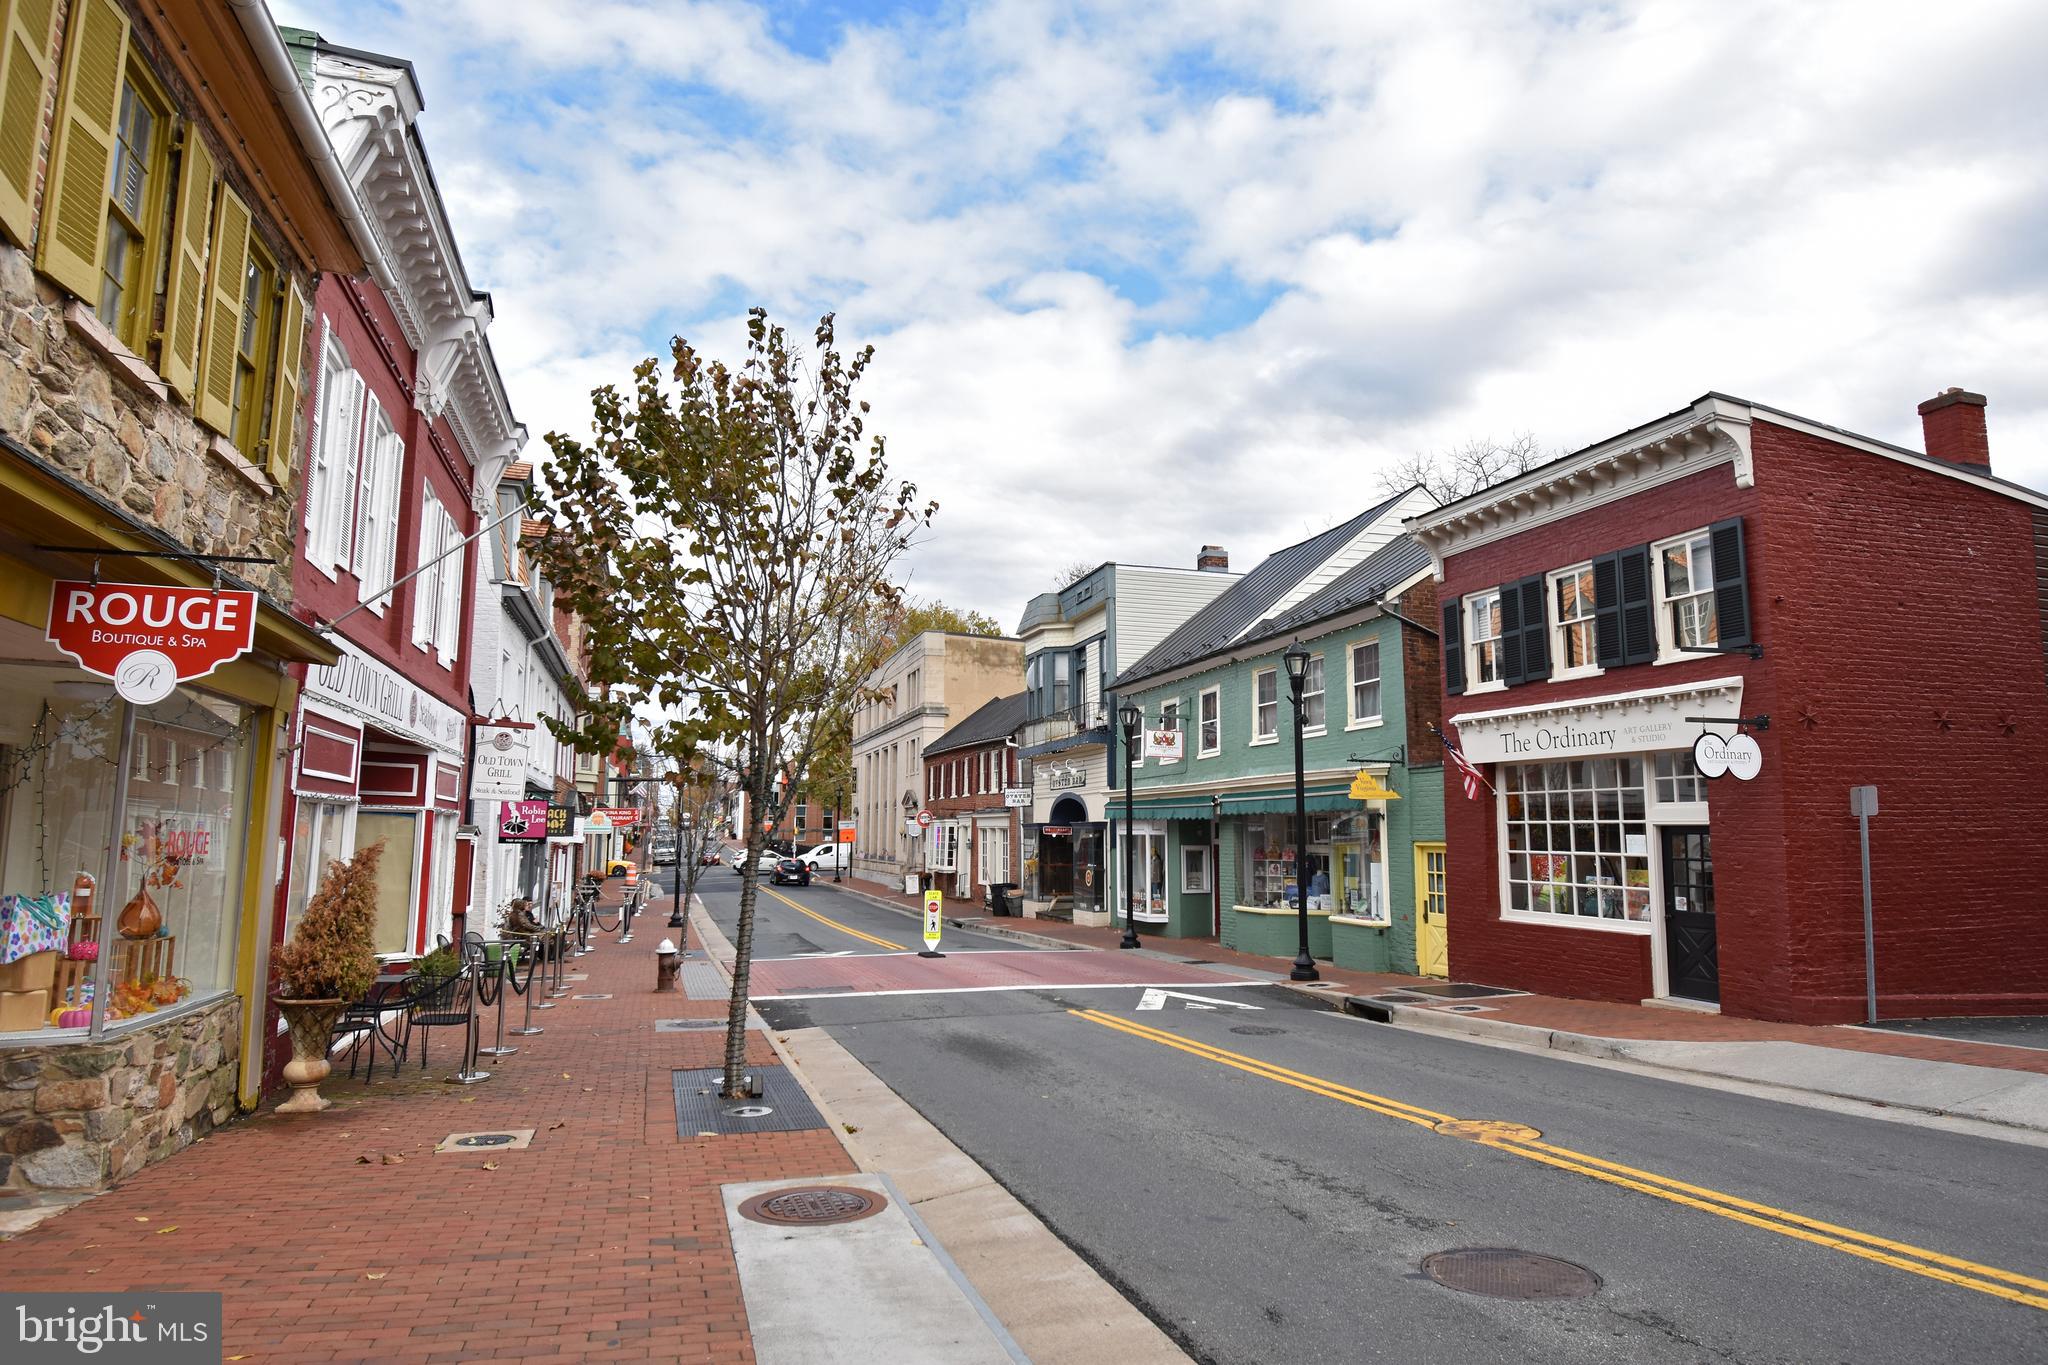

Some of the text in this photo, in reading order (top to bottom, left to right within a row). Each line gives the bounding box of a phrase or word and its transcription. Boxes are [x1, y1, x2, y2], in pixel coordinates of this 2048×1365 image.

[66, 590, 239, 632] ROUGE
[168, 636, 177, 647] &
[347, 654, 382, 710] TOWN
[379, 673, 405, 722] GRILL
[1623, 722, 1673, 735] ART GALLERY
[1500, 726, 1617, 753] The Ordinary
[1638, 733, 1667, 743] STUDIO
[478, 754, 524, 767] OLD TOWN
[1704, 746, 1753, 763] Ordinary
[487, 766, 512, 778] GRILL
[522, 804, 547, 816] Robin
[531, 814, 547, 824] Lee
[167, 831, 210, 855] ROUGE
